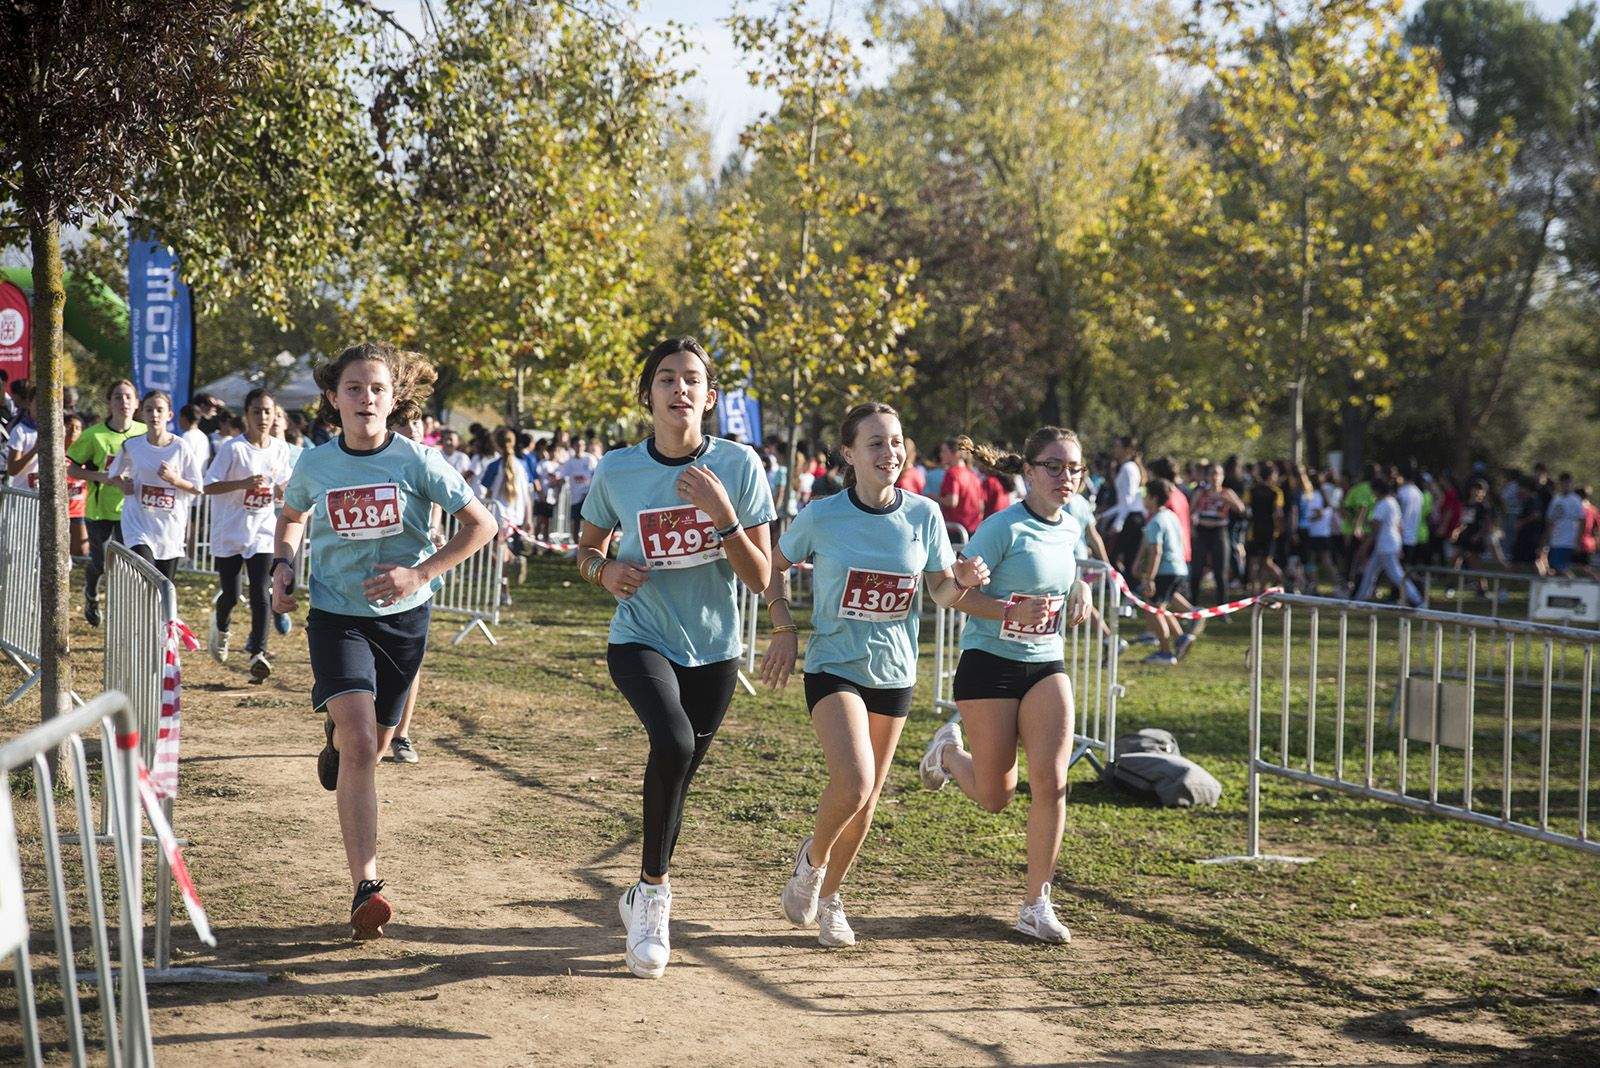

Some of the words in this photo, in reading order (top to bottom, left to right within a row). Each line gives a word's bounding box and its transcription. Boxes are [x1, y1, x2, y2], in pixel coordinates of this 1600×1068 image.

[142, 494, 174, 507] 4463
[334, 503, 397, 529] 1284
[648, 526, 720, 557] 1293
[847, 588, 909, 611] 1302
